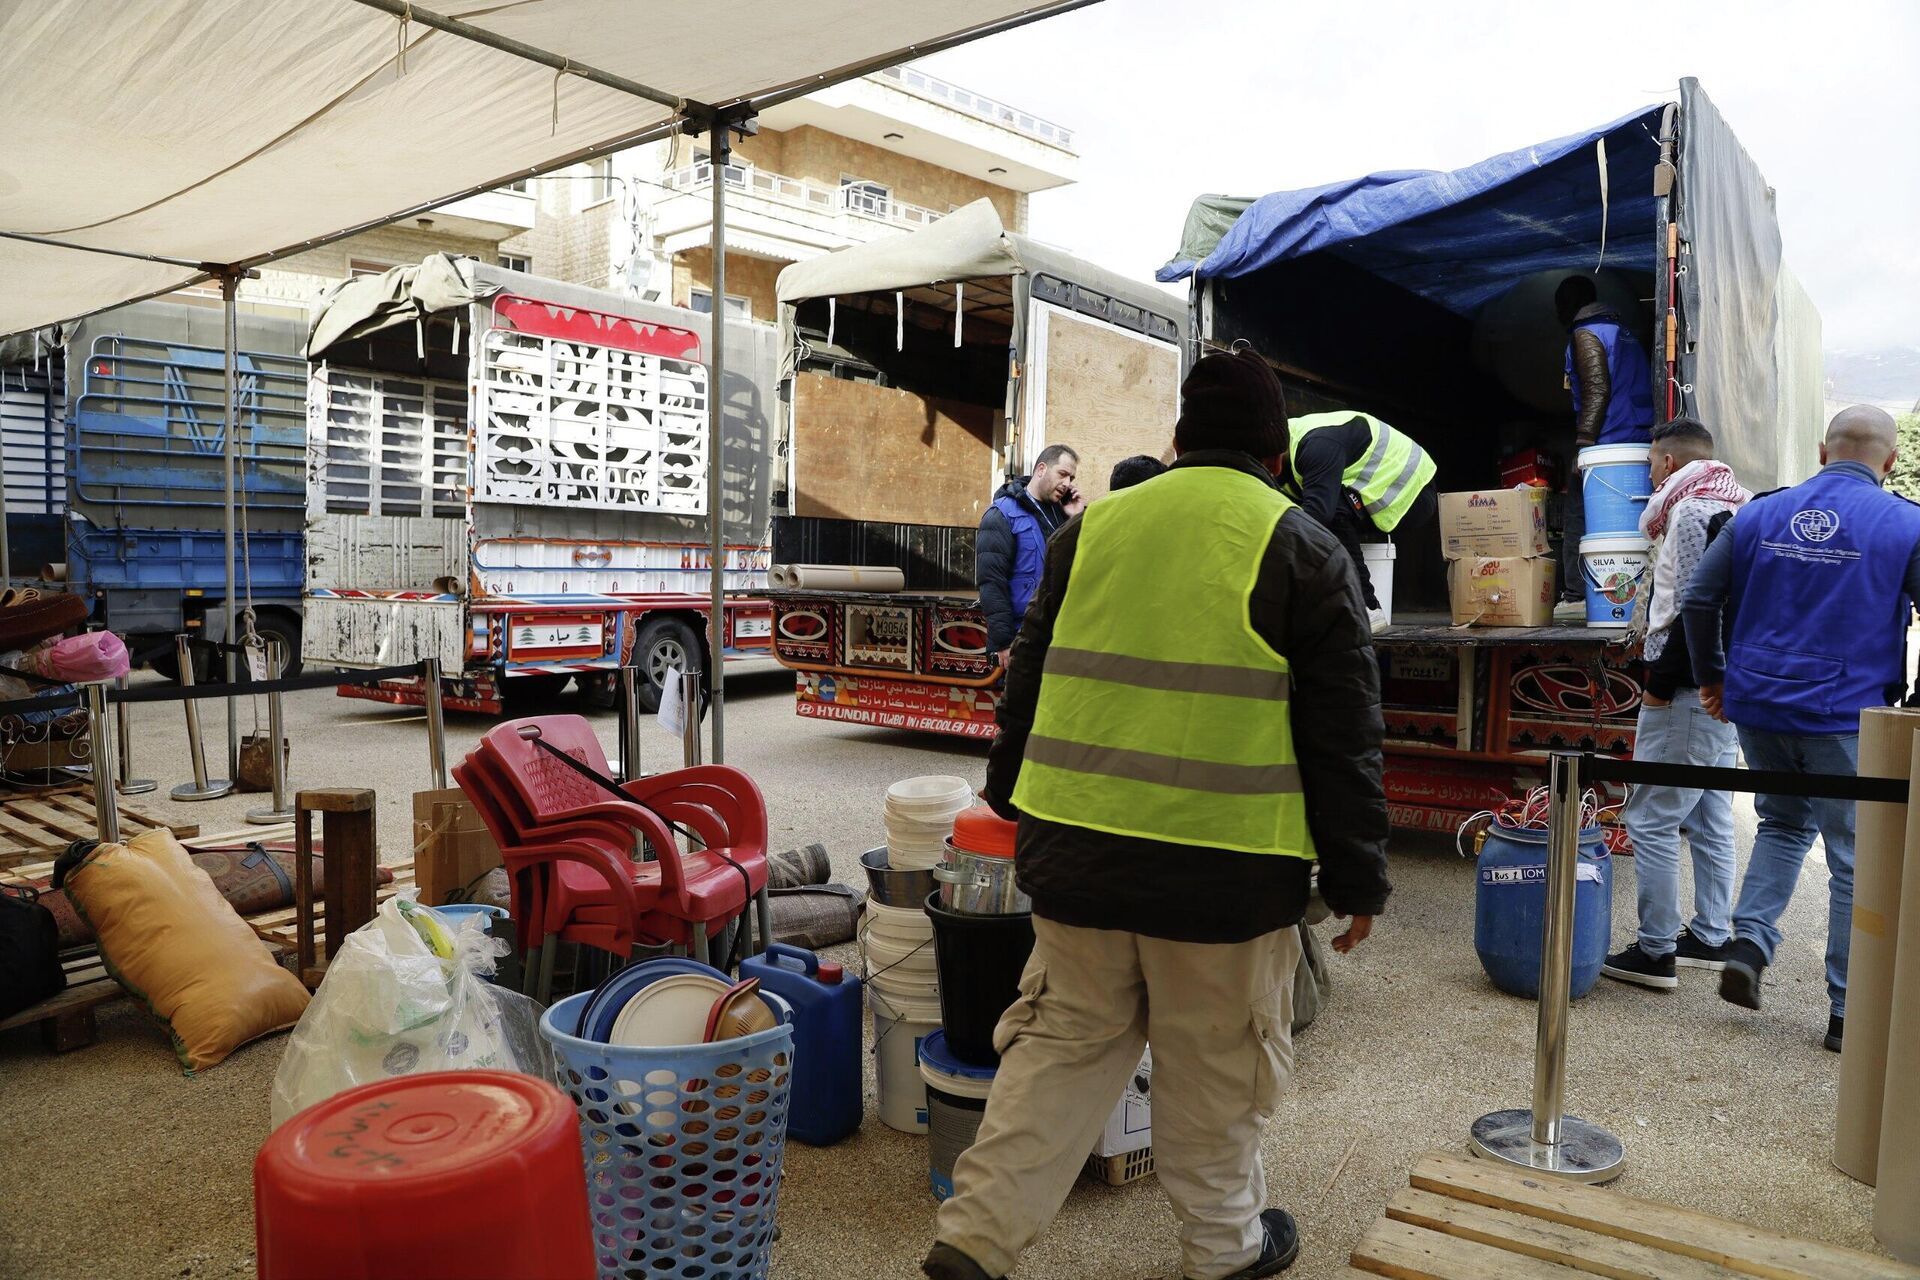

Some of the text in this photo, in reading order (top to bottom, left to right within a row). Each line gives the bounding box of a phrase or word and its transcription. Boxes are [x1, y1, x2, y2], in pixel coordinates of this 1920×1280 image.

[1593, 558, 1615, 566] SILVA
[549, 628, 570, 646] مياه
[816, 705, 877, 723] HYUNDAI
[907, 715, 966, 734] INTERCOOLER
[965, 723, 980, 736] HD
[1523, 869, 1545, 879] IOM
